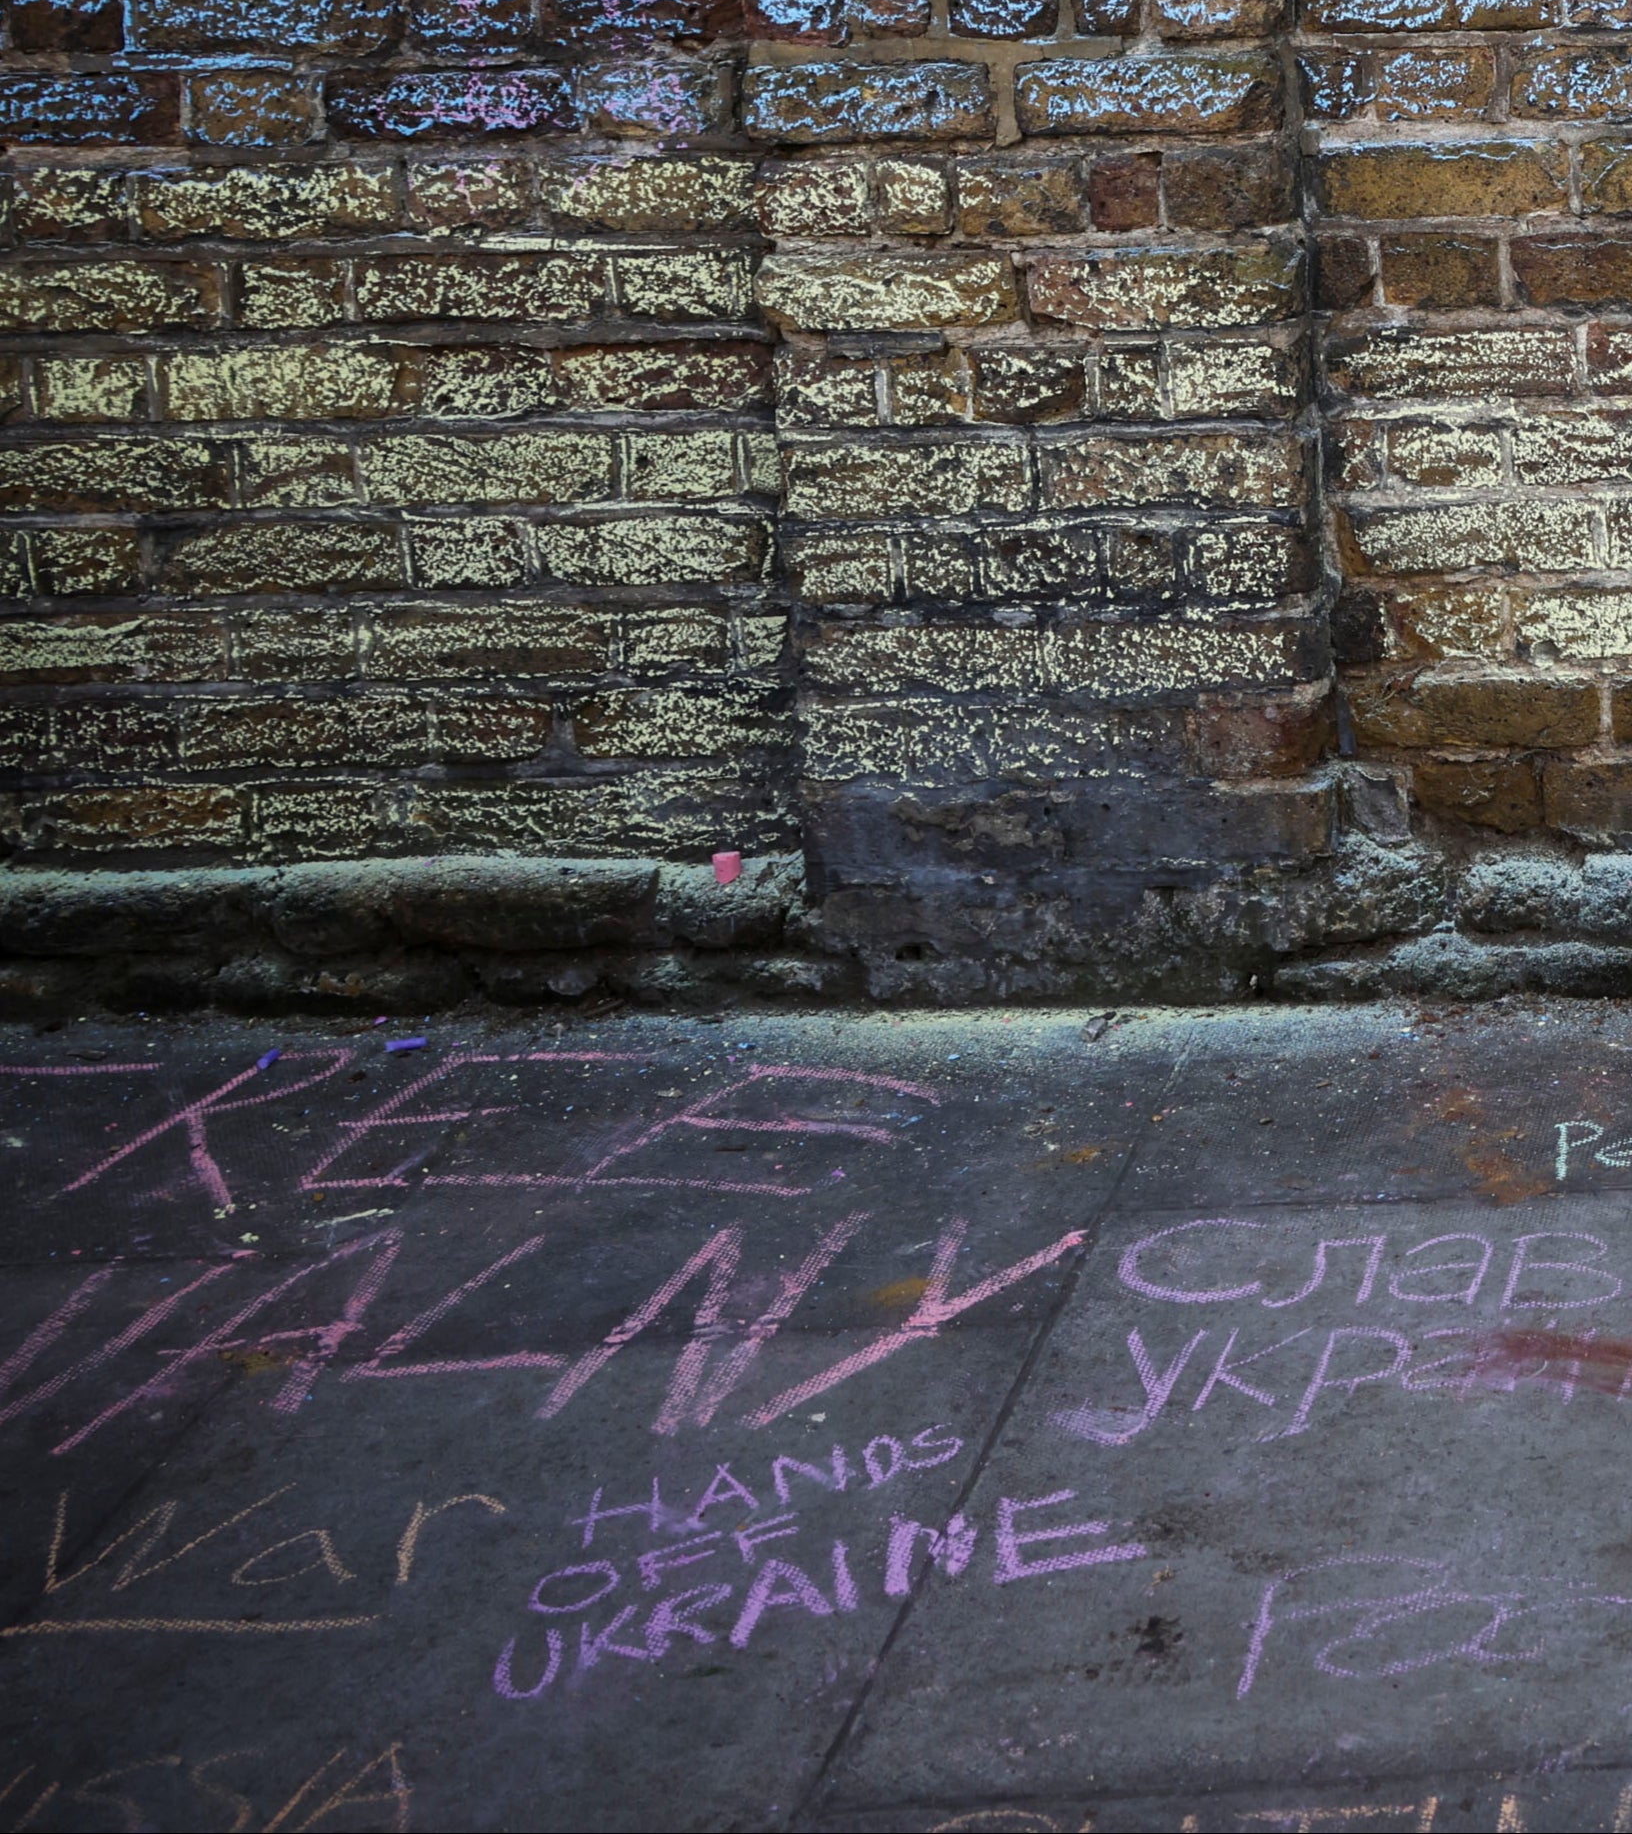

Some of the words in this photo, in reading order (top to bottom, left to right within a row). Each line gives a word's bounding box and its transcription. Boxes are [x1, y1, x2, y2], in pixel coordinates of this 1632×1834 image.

[571, 1422, 965, 1549] HANDS
[492, 1489, 1147, 1703] UKRAINE
[526, 1512, 801, 1615] OFF
